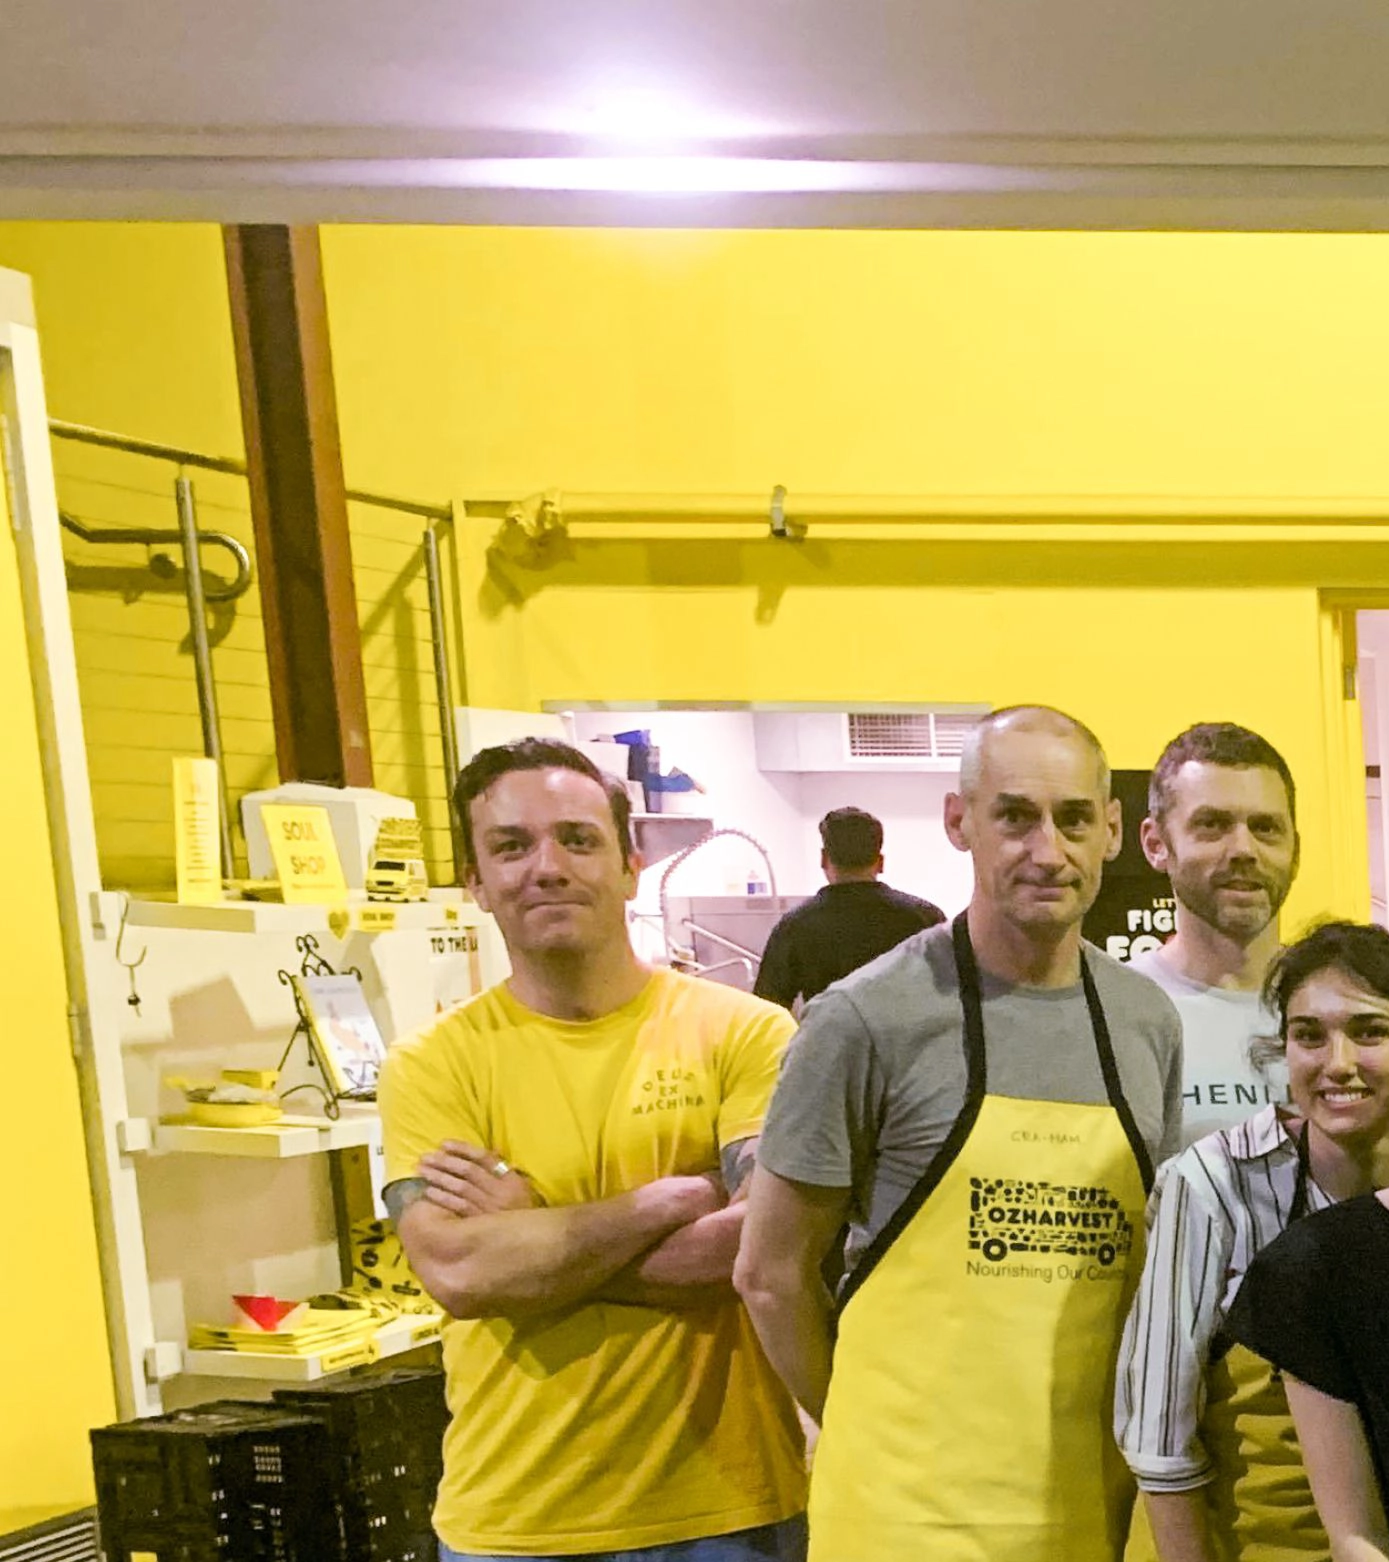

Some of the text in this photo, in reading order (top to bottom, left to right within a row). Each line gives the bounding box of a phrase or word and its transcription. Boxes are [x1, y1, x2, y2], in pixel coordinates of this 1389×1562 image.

[281, 821, 320, 842] SOUL
[290, 855, 326, 875] SHOP
[632, 1093, 705, 1115] MACHINA
[988, 1206, 1113, 1229] OZHARVEST
[966, 1260, 1053, 1283] Nourishing
[1056, 1264, 1086, 1280] Our
